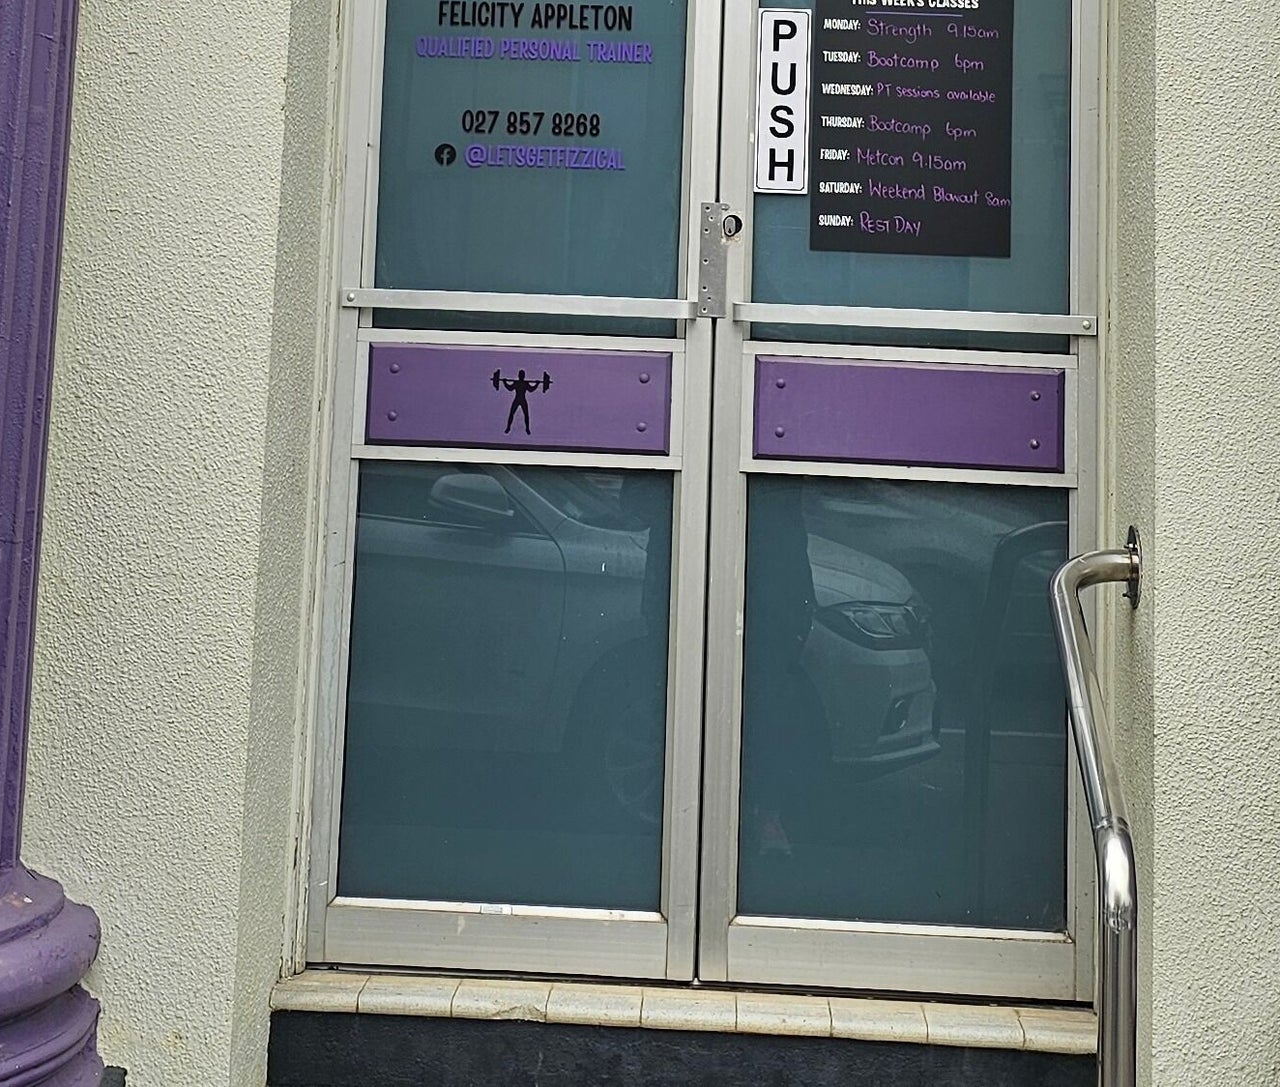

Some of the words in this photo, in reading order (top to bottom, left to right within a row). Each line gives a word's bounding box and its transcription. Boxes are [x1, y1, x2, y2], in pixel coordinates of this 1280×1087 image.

[438, 0, 524, 29] FELICITY
[531, 3, 633, 31] APPLETON
[823, 18, 861, 30] MONDAY:
[867, 18, 932, 44] Strength
[416, 36, 494, 59] QUALIFIED
[500, 38, 581, 62] PERSONAL
[587, 40, 653, 64] TRAINER
[823, 50, 861, 63] TUESDAY:
[867, 50, 939, 72] Bootcamp
[954, 53, 984, 73] 6pm
[769, 19, 798, 182] PUSH
[822, 83, 874, 96] WEDNESDAY:
[877, 82, 892, 96] PT
[896, 85, 940, 100] sessions
[947, 89, 996, 103] available
[462, 109, 499, 134] 027
[507, 111, 544, 135] 857
[551, 113, 600, 137] 8268
[821, 116, 865, 129] THURSDAY:
[867, 114, 931, 142] Bootcamp
[946, 121, 977, 141] 6pm
[465, 143, 626, 170] @LETSGETFIZZICAL
[820, 148, 850, 161] FRIDAY:
[912, 151, 967, 171] 9.15am
[819, 182, 862, 195] SATURDAY:
[869, 178, 925, 201] Weekend
[933, 186, 979, 205] Blowout
[985, 191, 1011, 207] 8am
[818, 215, 854, 227] SUNDAY:
[894, 215, 921, 237] DAY
